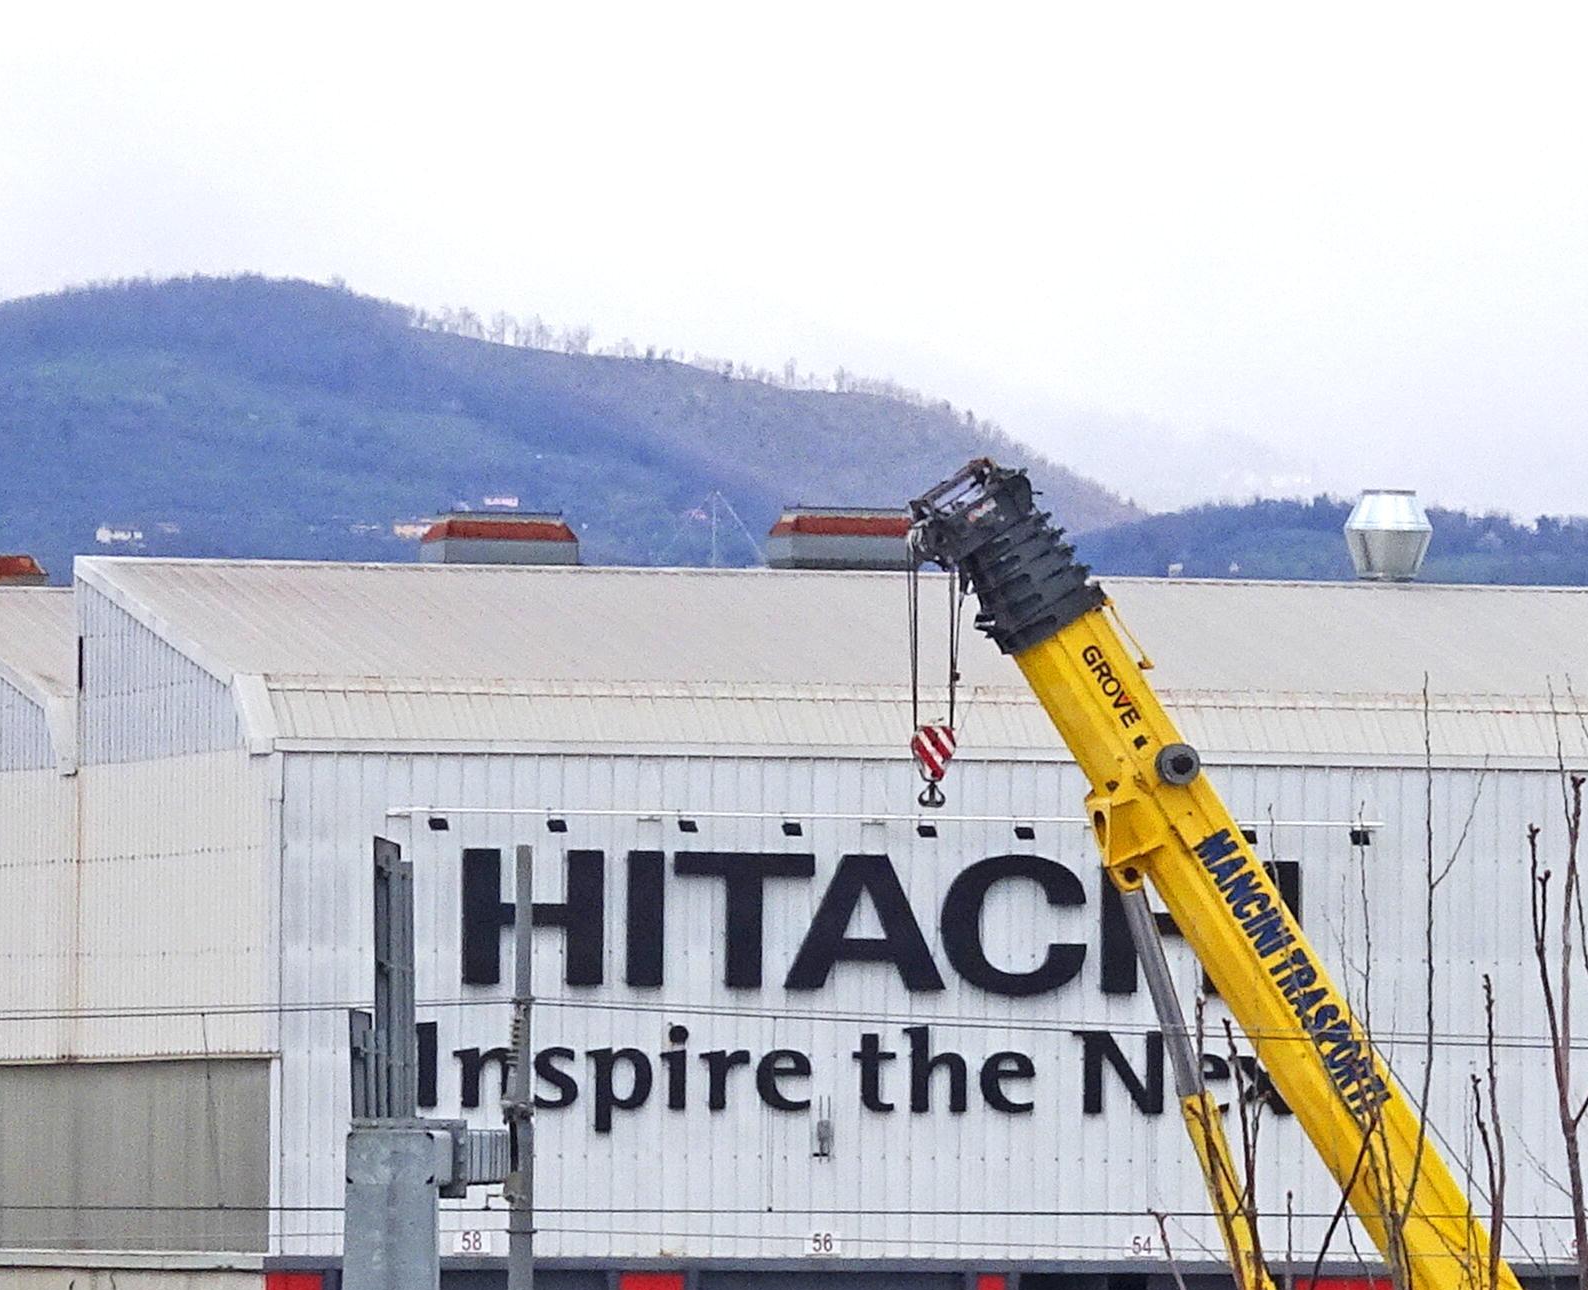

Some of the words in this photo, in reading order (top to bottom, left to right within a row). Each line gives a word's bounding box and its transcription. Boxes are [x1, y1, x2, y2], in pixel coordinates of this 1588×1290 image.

[1082, 645, 1141, 728] GROVE
[1193, 828, 1296, 959] MANCINI
[415, 1020, 812, 1134] Inspire
[853, 1025, 1036, 1114] the
[462, 1231, 482, 1251] 58
[812, 1233, 833, 1252] 56
[1132, 1236, 1152, 1254] 54
